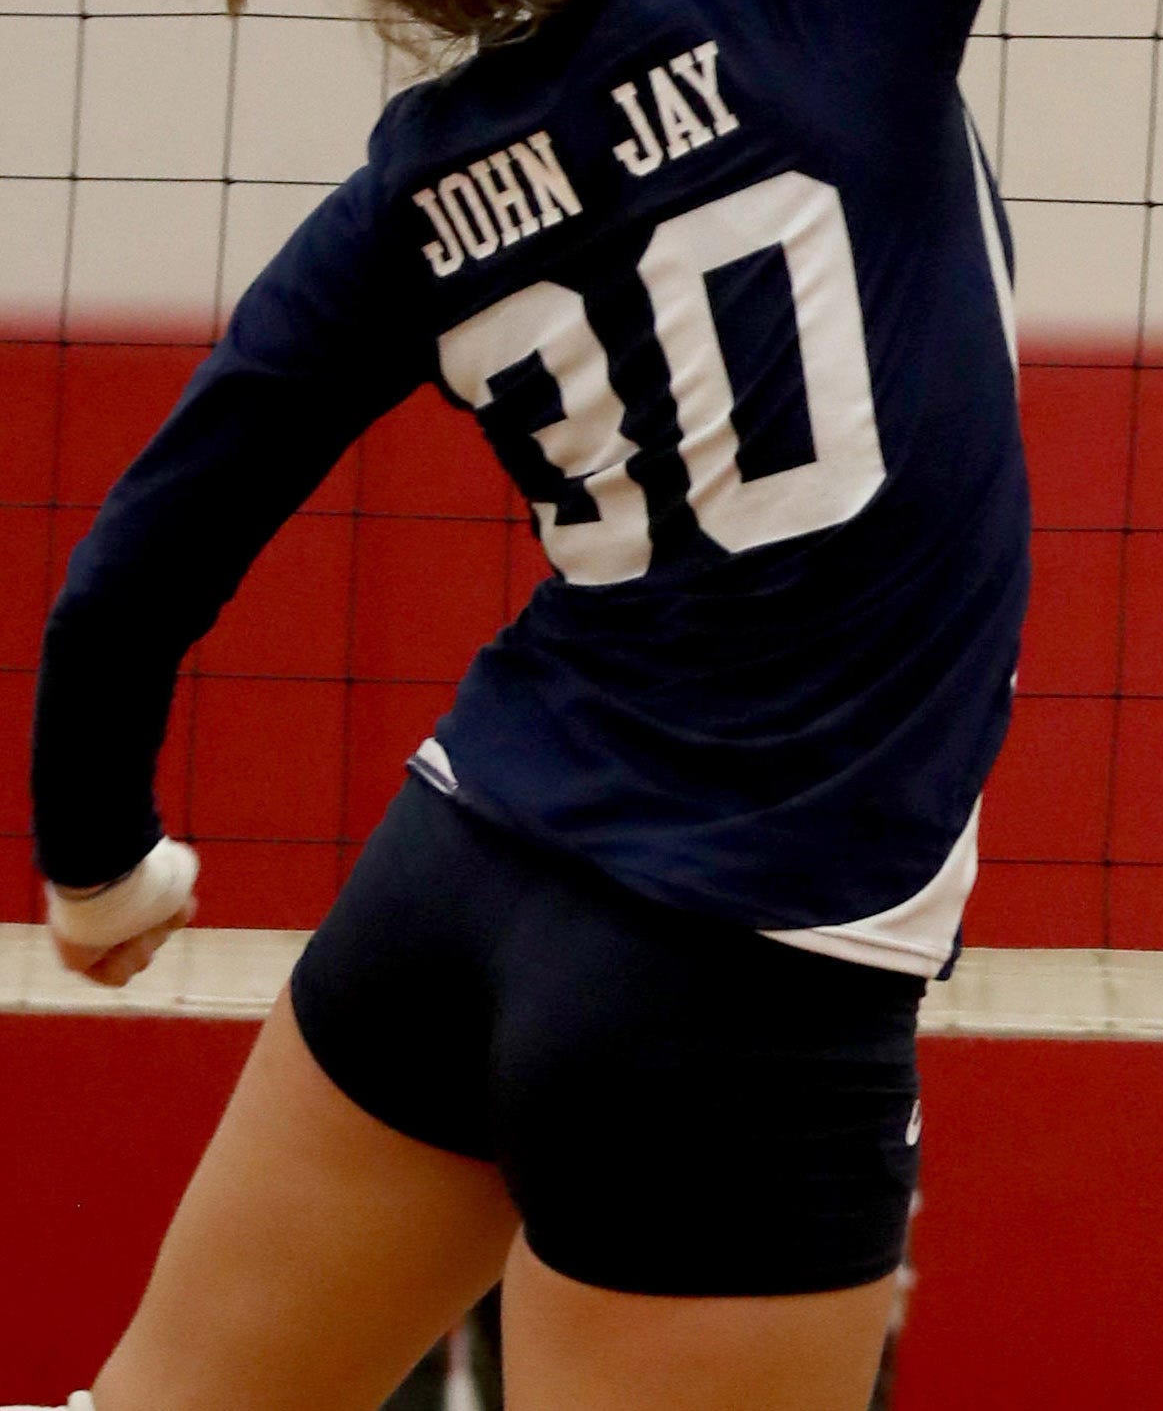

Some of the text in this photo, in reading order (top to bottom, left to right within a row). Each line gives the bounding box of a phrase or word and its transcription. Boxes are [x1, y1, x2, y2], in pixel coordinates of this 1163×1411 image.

[411, 40, 741, 278] JOHN JAY
[437, 169, 887, 587] 30
